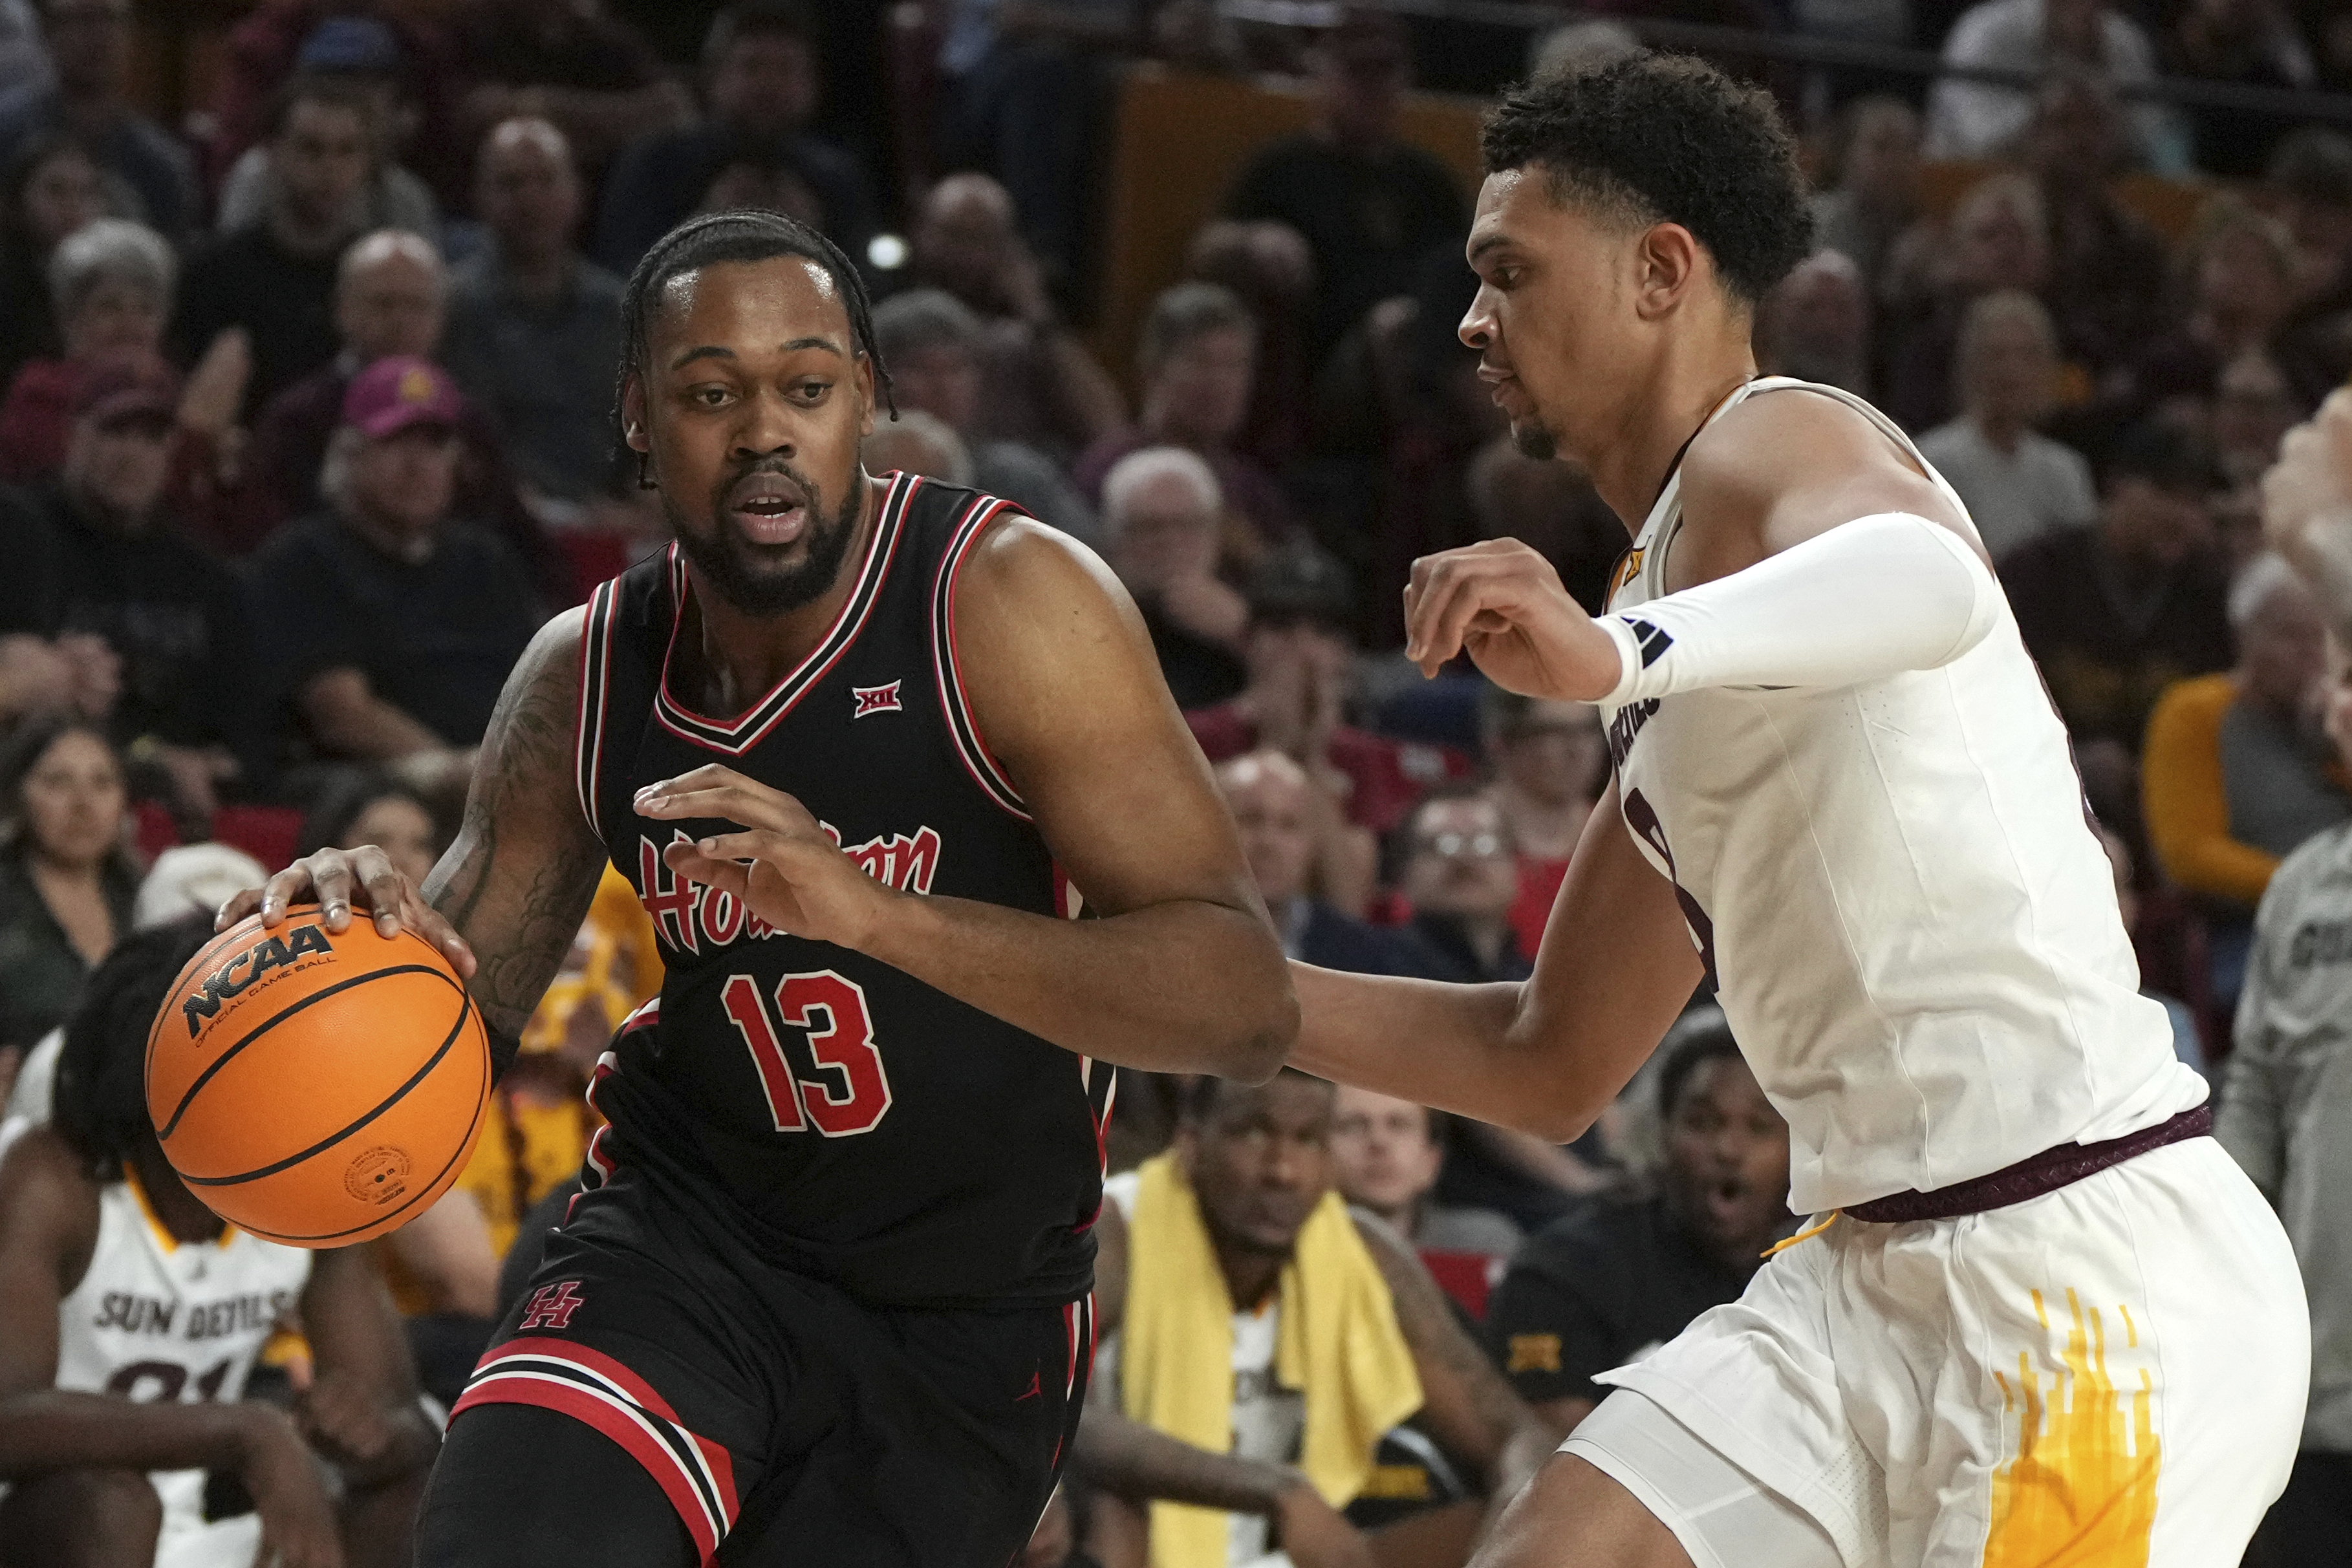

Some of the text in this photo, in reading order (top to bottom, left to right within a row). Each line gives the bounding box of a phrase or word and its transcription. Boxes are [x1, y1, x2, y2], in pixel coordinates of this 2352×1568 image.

[639, 820, 941, 956] Hoon
[182, 923, 333, 1040] NCAA
[195, 957, 338, 1048] OFFICIAL GAME BALL
[720, 969, 892, 1138] 13
[94, 1291, 177, 1336] SUN
